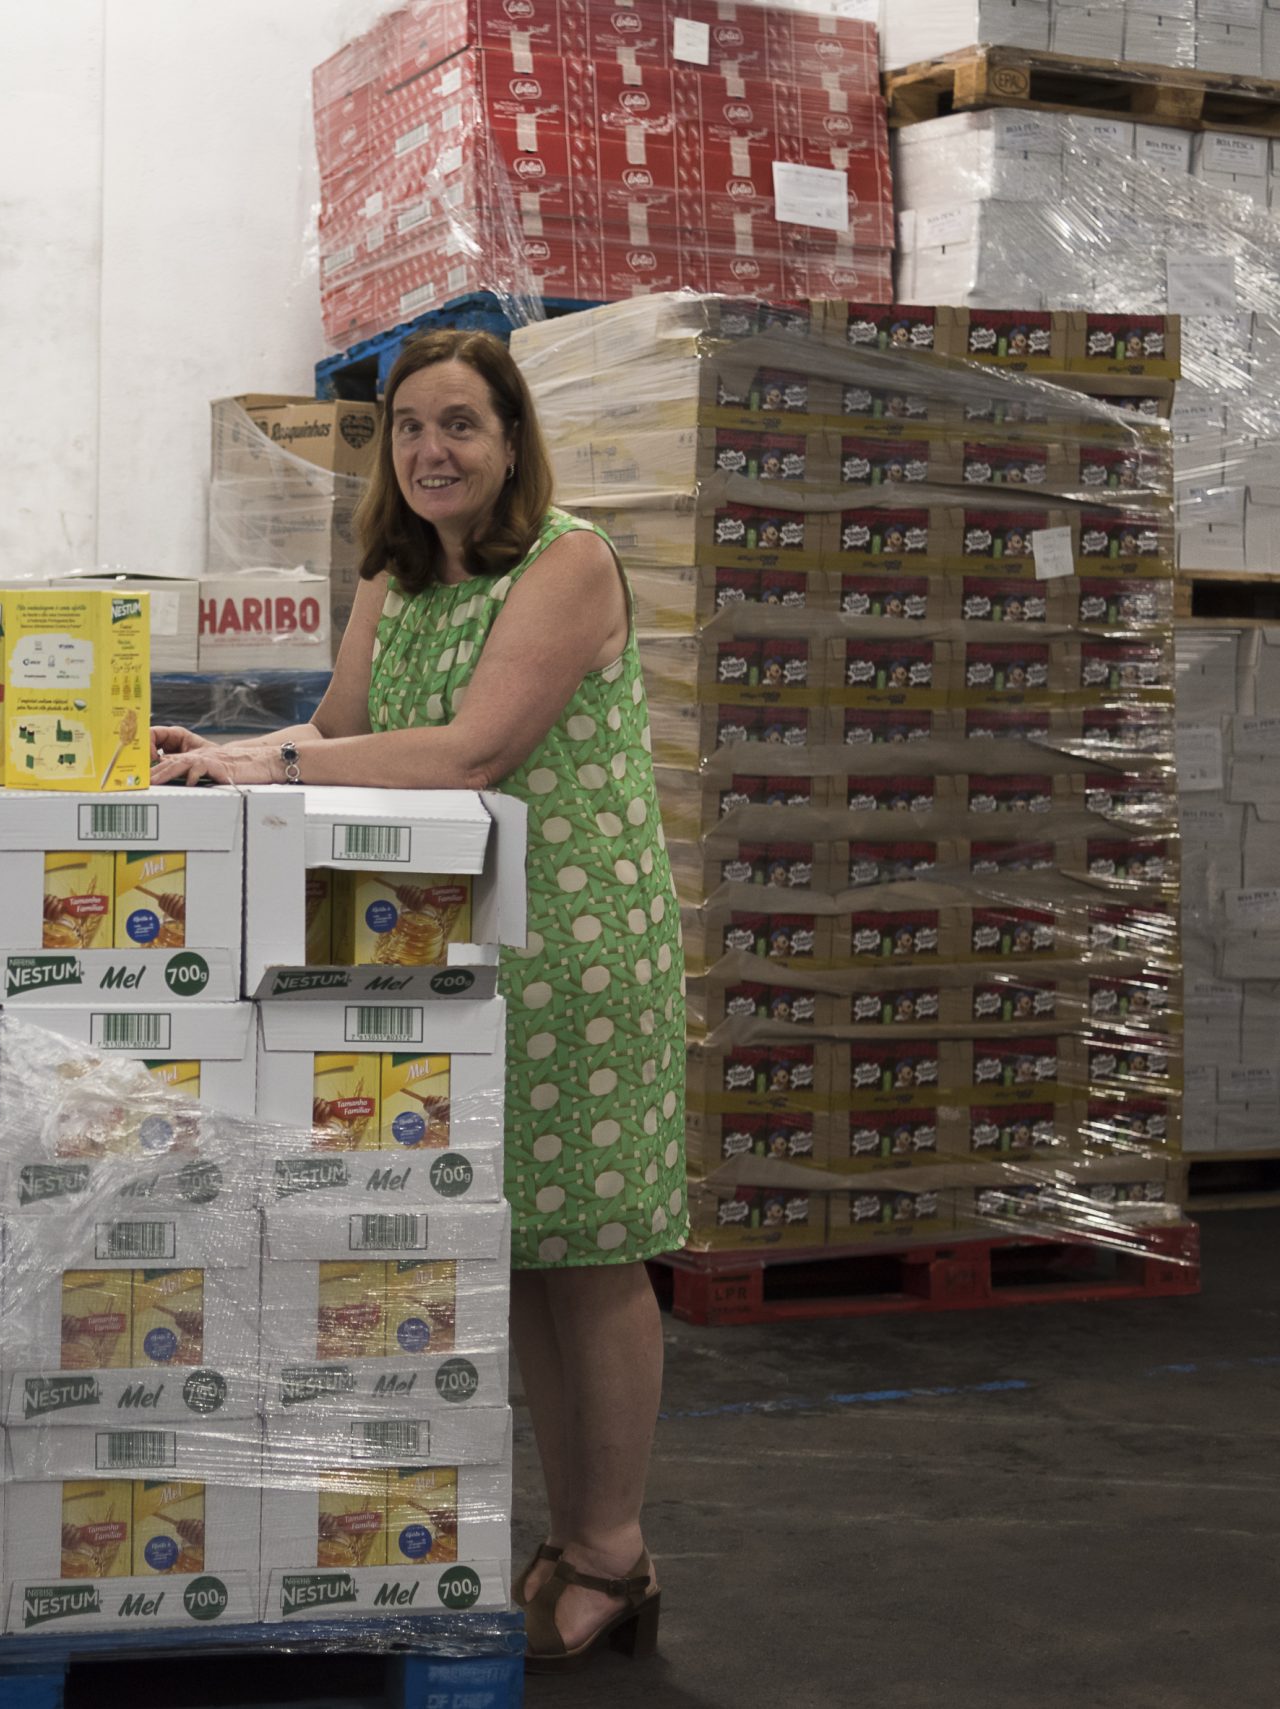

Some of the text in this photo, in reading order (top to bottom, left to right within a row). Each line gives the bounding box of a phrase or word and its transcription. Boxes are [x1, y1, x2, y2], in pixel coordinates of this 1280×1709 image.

[199, 597, 320, 635] HARIBO
[140, 859, 164, 880] Mel
[70, 898, 101, 906] Tamanho
[77, 904, 104, 913] Familiar
[6, 962, 207, 989] NESTUM Mel 700g
[273, 975, 472, 991] NESTUM Mel 700g
[407, 1060, 431, 1082] Mel
[337, 1100, 367, 1108] Tamanho
[344, 1107, 372, 1115] Familiar
[366, 1167, 471, 1191] Mel 700g
[373, 1373, 417, 1398] Mel
[438, 1372, 477, 1390] 700g
[23, 1383, 99, 1410] NESTUM
[117, 1384, 164, 1408] Mel
[158, 1486, 182, 1505] Mel
[88, 1524, 119, 1533] Tamanho
[94, 1532, 121, 1540] Familiar
[282, 1579, 478, 1607] NESTUM Mel 700g
[23, 1590, 226, 1619] NESTUM Mel 700g
